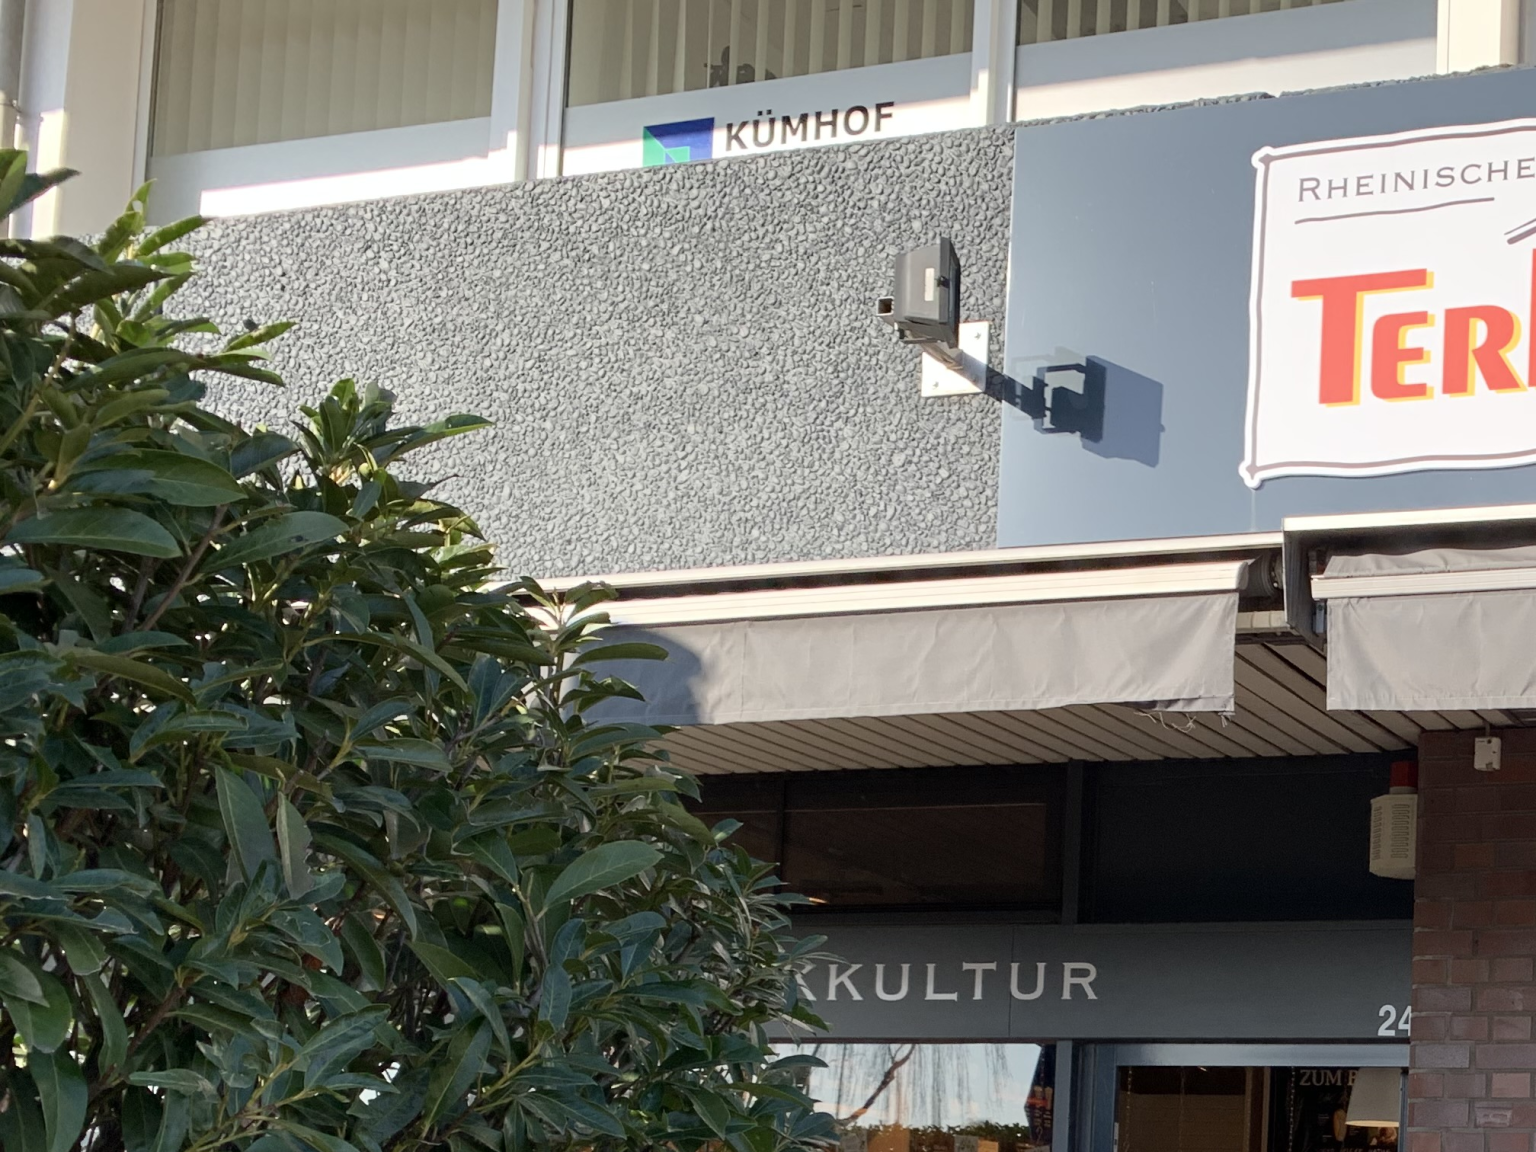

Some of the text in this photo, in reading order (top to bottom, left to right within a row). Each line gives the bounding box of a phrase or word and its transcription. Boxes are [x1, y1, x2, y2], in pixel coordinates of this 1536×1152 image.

[725, 101, 895, 152] KÜMHOF
[1298, 156, 1536, 204] RHEINISCHE
[793, 961, 1098, 1001] KKULTUR
[1377, 1004, 1412, 1037] 24
[1300, 1070, 1342, 1087] ZUM
